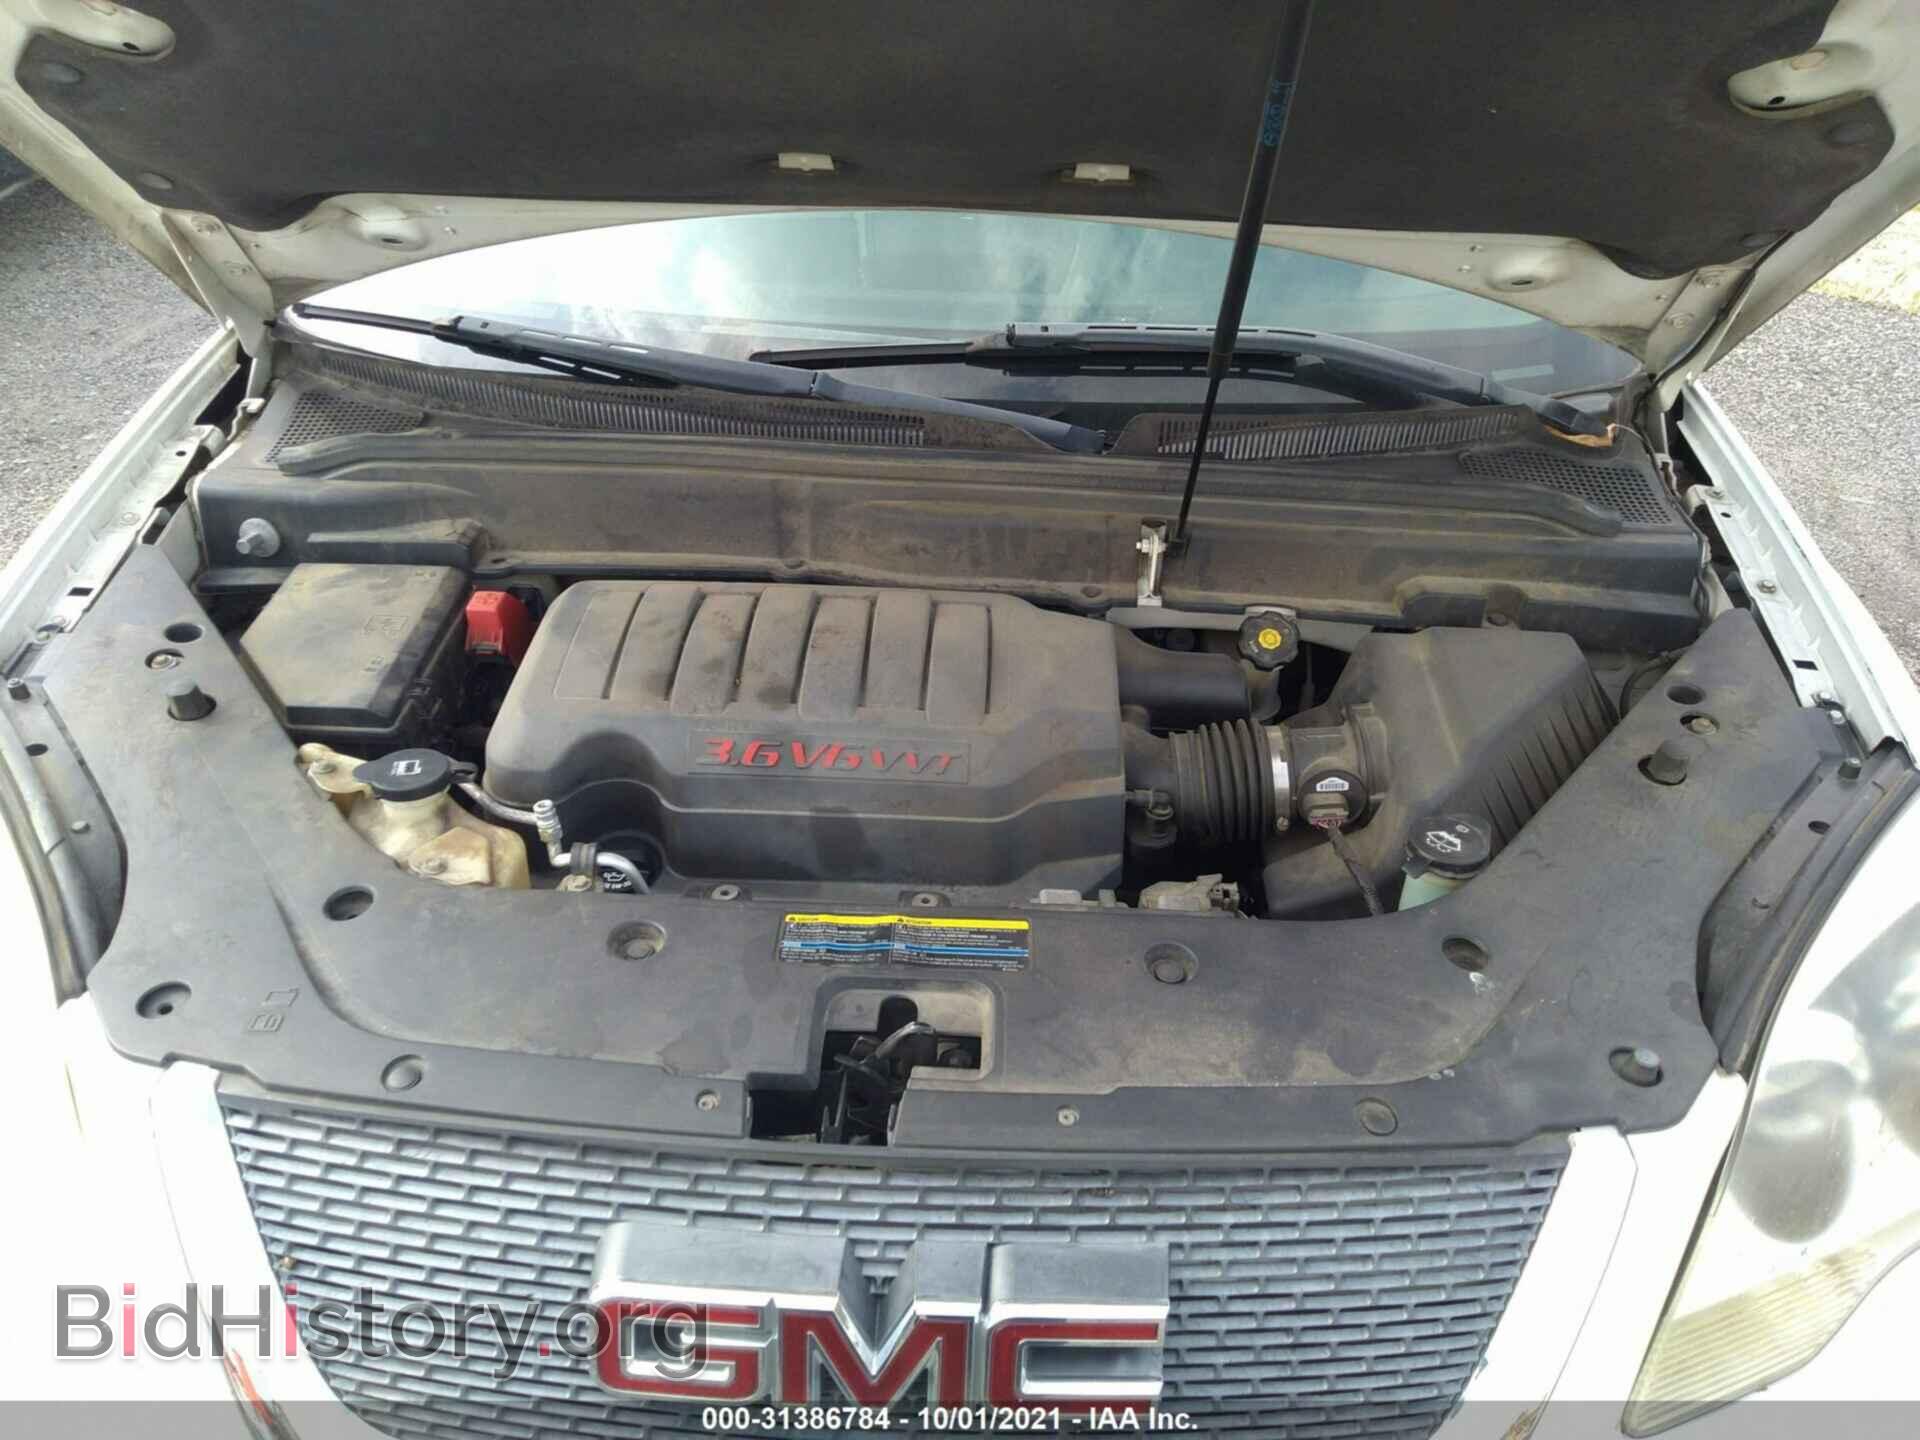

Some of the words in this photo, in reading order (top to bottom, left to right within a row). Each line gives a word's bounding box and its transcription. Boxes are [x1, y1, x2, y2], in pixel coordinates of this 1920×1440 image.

[696, 737, 782, 768] 3.6
[790, 738, 866, 772] V6
[871, 744, 962, 775] VVT
[590, 1282, 1169, 1415] GMC
